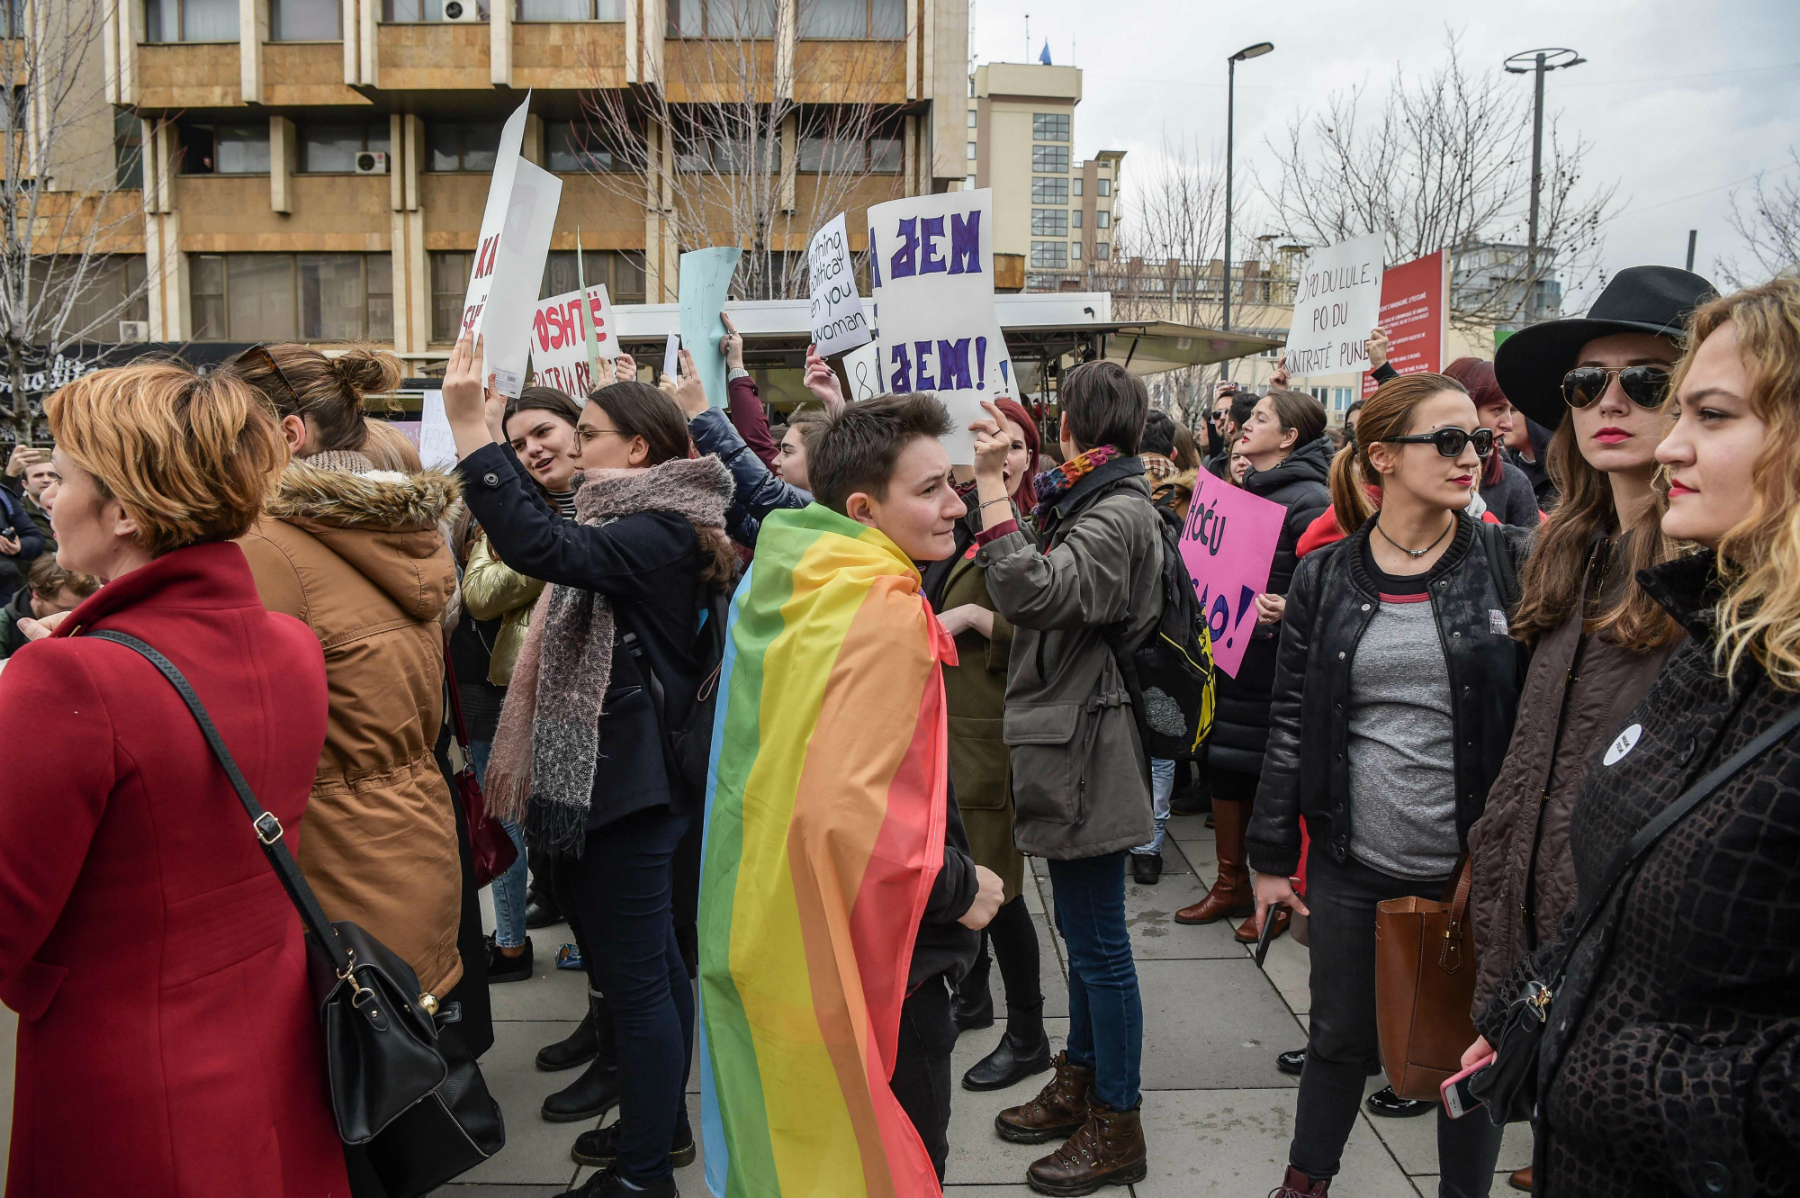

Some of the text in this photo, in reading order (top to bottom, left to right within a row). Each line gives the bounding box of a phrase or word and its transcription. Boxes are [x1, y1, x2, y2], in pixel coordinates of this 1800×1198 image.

[824, 281, 852, 317] you
[1312, 305, 1329, 333] PO
[1332, 302, 1348, 328] DU
[1191, 578, 1256, 649] AO!
